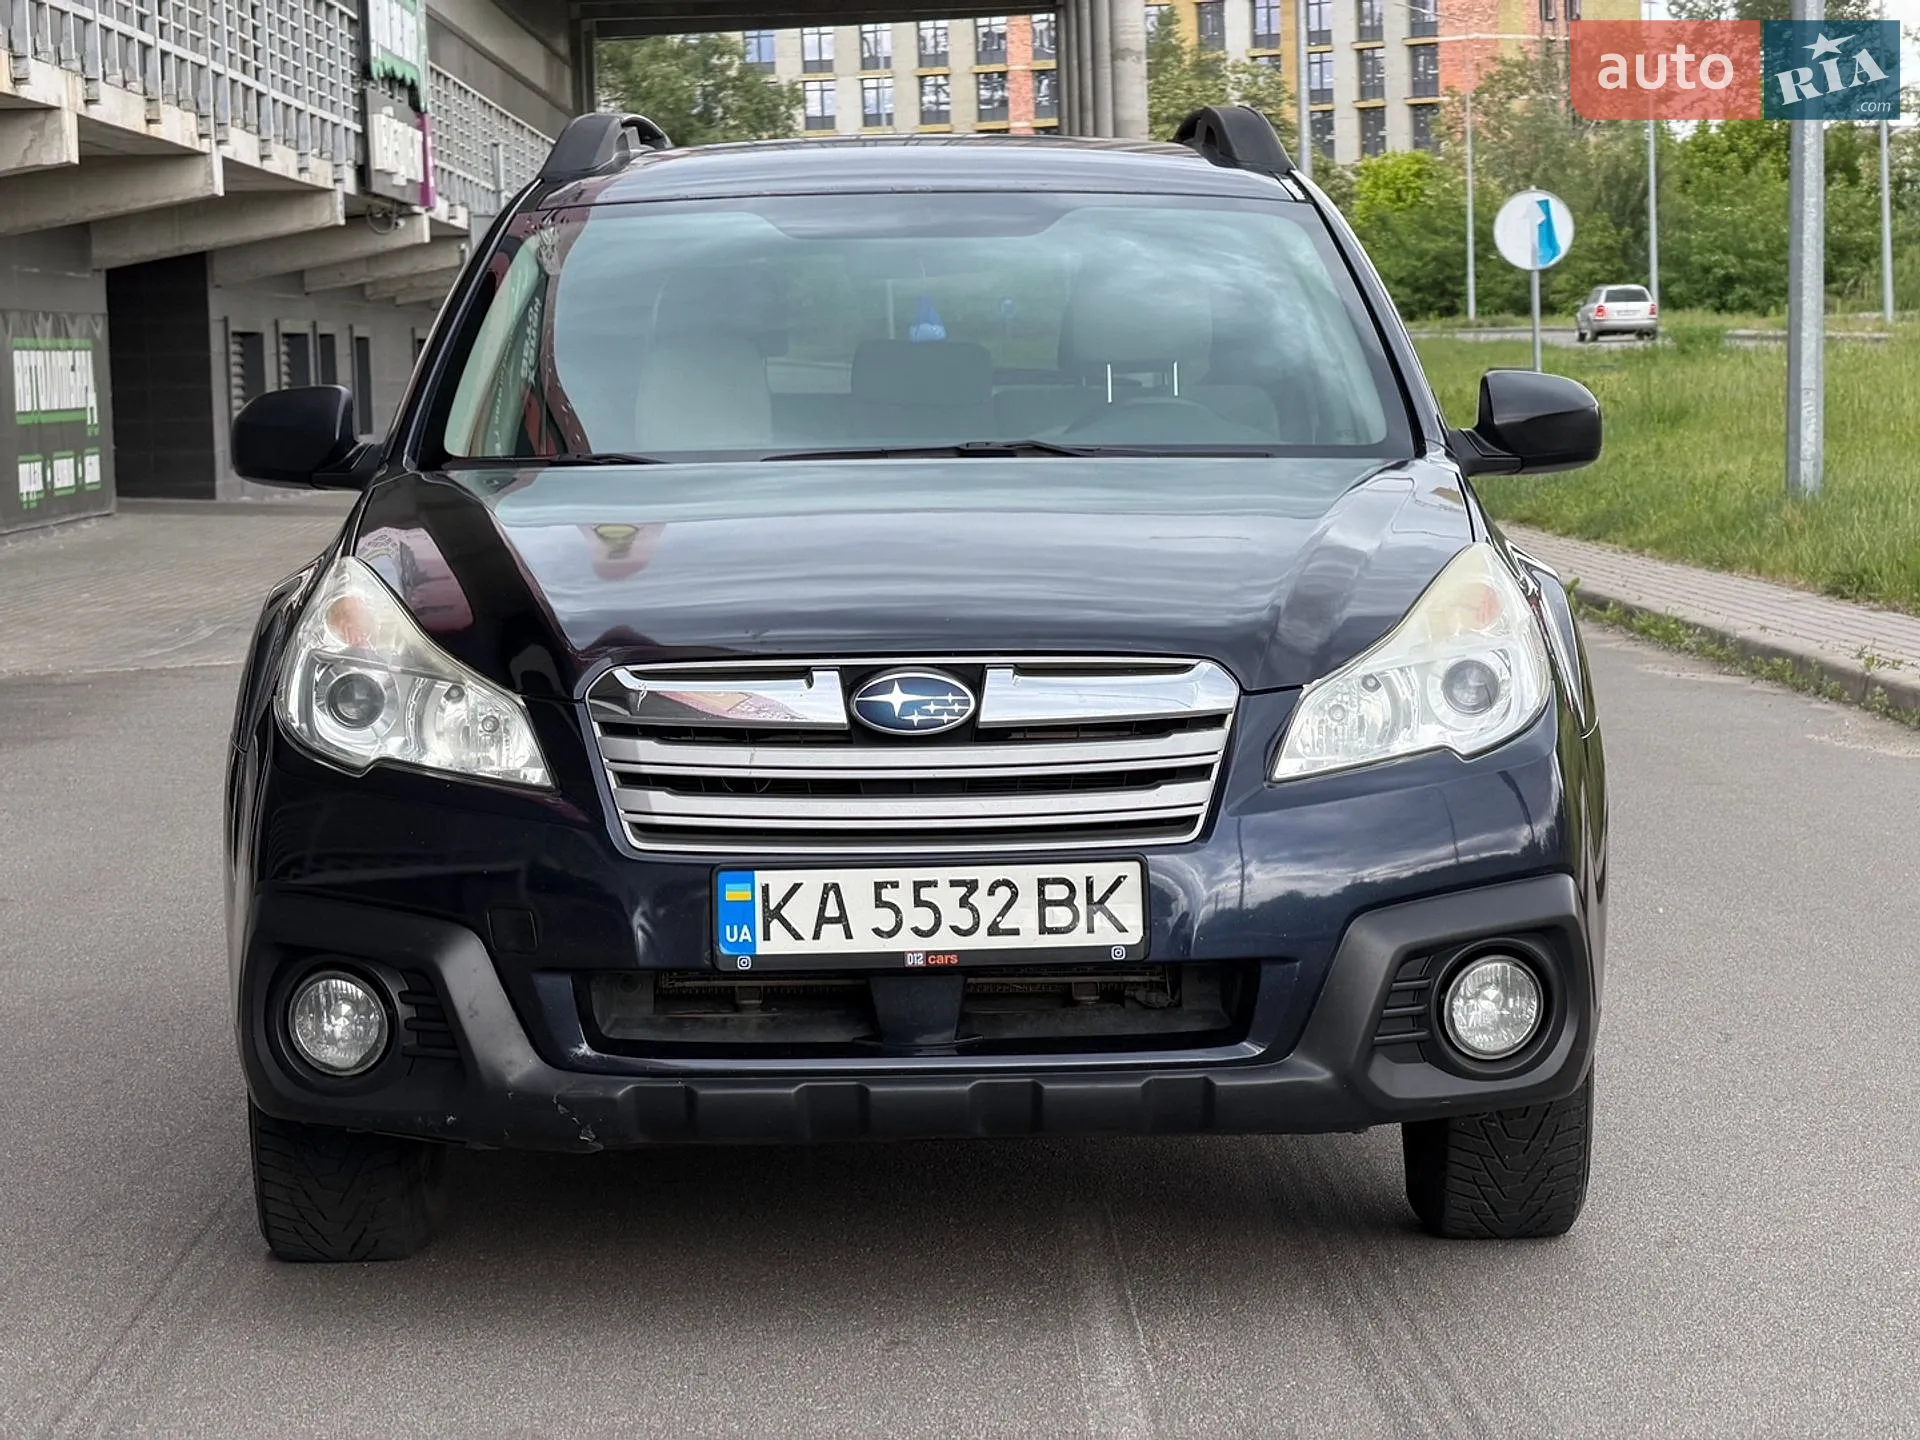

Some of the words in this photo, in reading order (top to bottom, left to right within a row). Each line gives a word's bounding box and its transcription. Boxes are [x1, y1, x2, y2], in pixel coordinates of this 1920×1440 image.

[761, 882, 853, 941] KA
[871, 878, 1020, 939] 5532
[1037, 875, 1129, 935] BK
[725, 925, 752, 944] UA
[928, 953, 958, 965] cars
